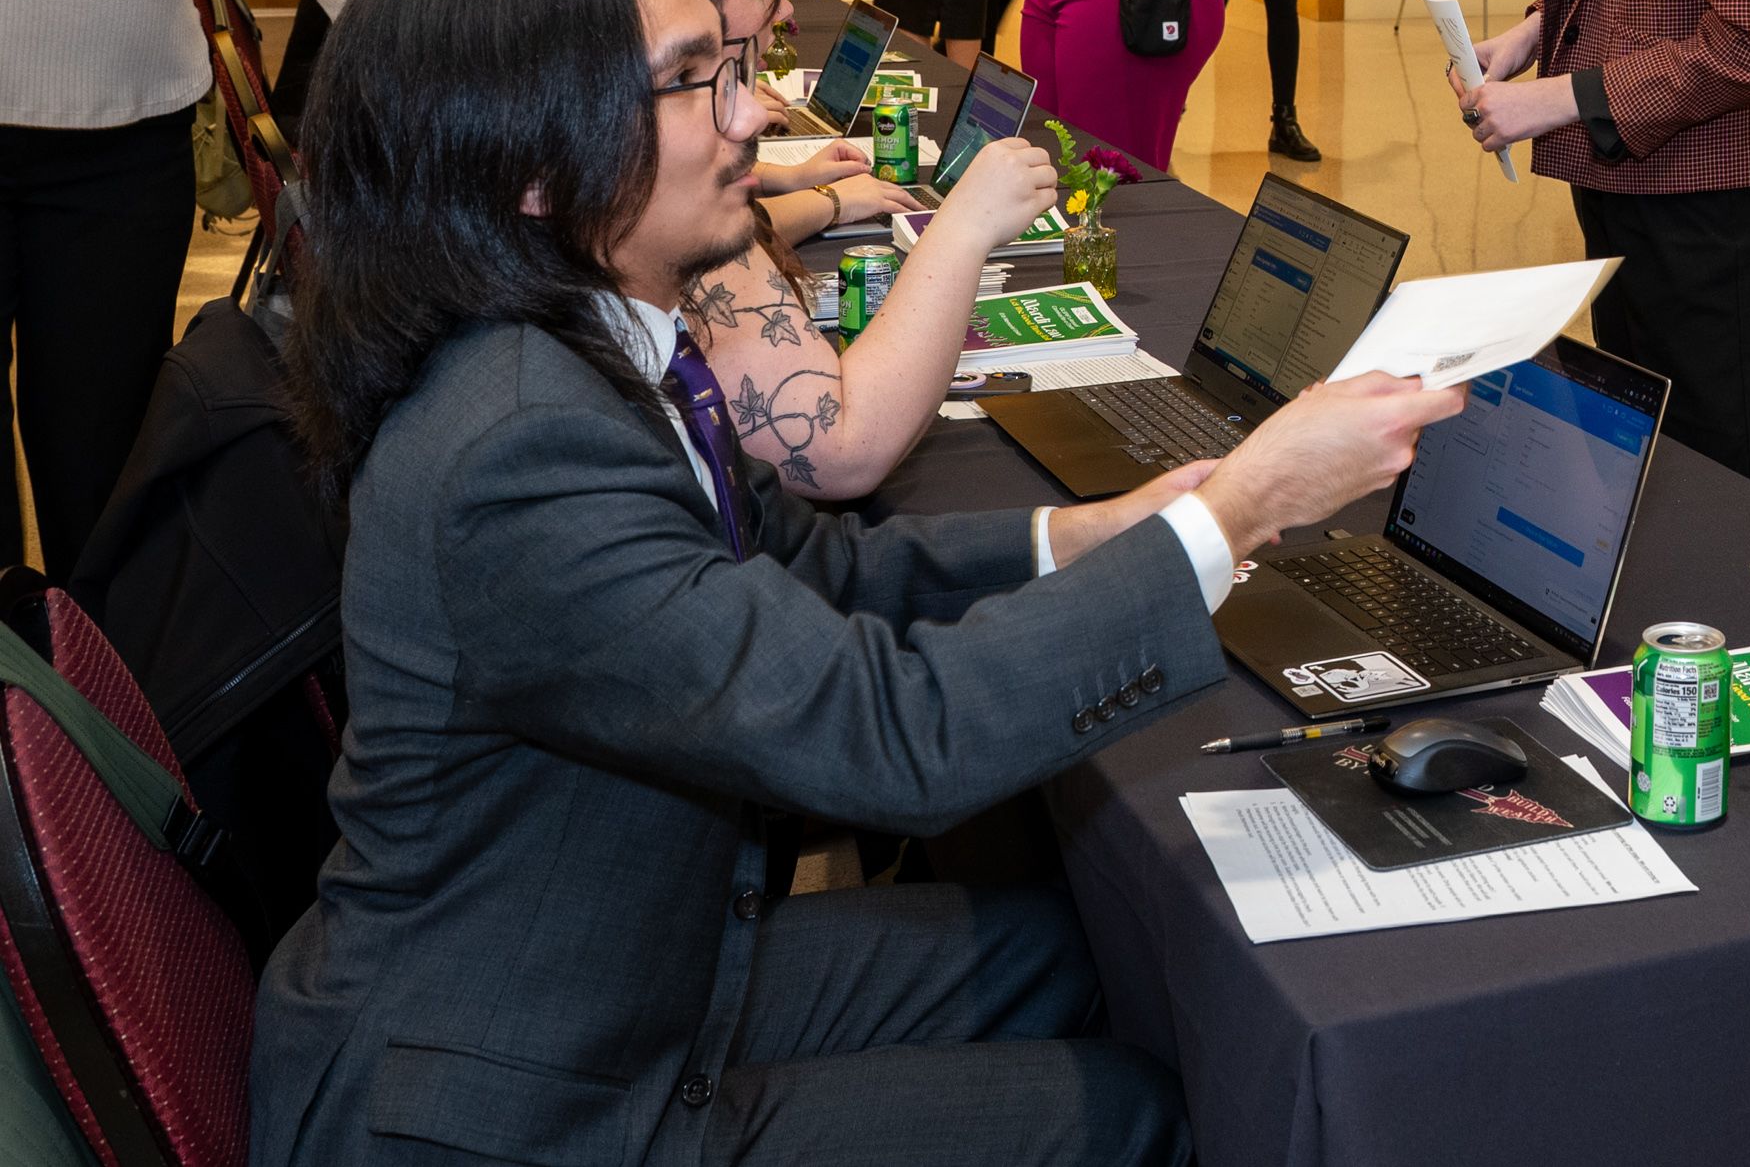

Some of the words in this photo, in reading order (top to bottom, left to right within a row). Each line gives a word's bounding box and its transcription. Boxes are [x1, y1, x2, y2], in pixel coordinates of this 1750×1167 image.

[1020, 299, 1051, 324] Mardi
[1041, 324, 1065, 339] Law
[1659, 663, 1681, 673] Nutrition
[1682, 665, 1697, 674] Facts
[1656, 686, 1680, 695] Calories
[1682, 687, 1697, 696] 150
[1488, 805, 1557, 822] WEALTH
[1507, 795, 1549, 816] BUILD
